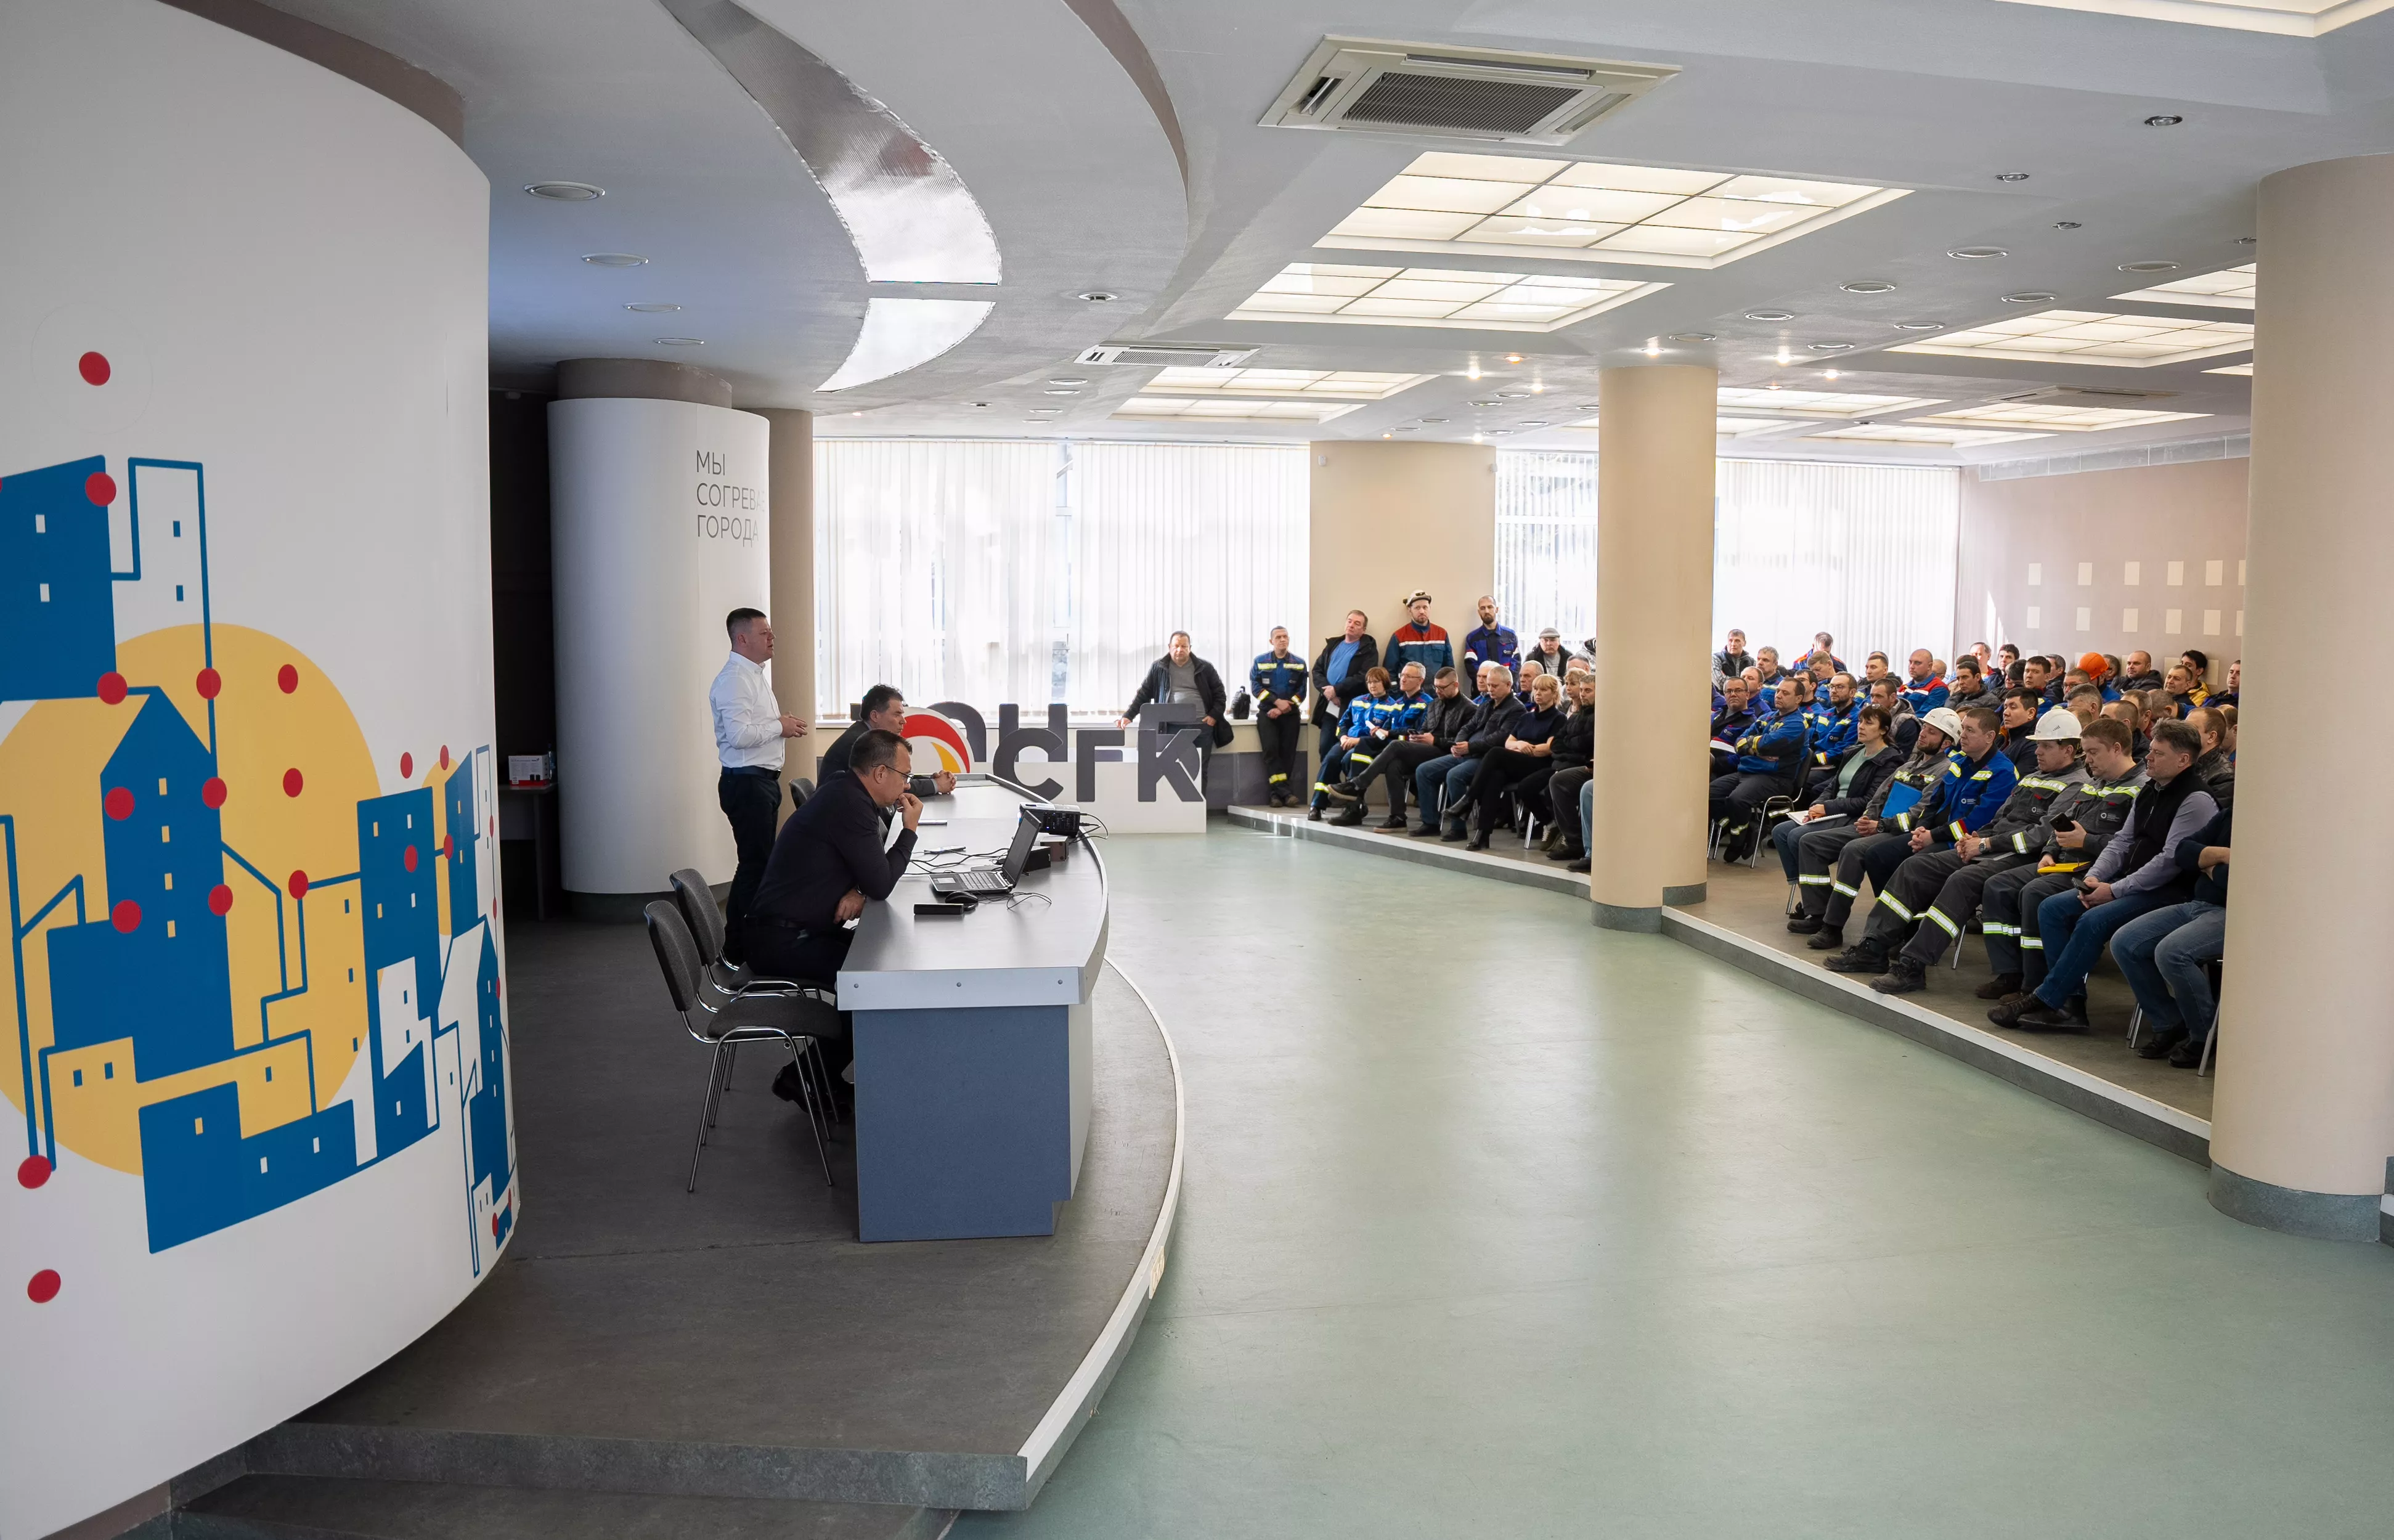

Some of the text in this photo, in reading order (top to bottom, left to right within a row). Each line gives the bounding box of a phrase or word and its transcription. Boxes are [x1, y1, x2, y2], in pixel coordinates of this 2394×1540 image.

[696, 450, 725, 476] МЫ
[697, 514, 759, 548] ГОРОДА
[993, 727, 1204, 802] СГК
